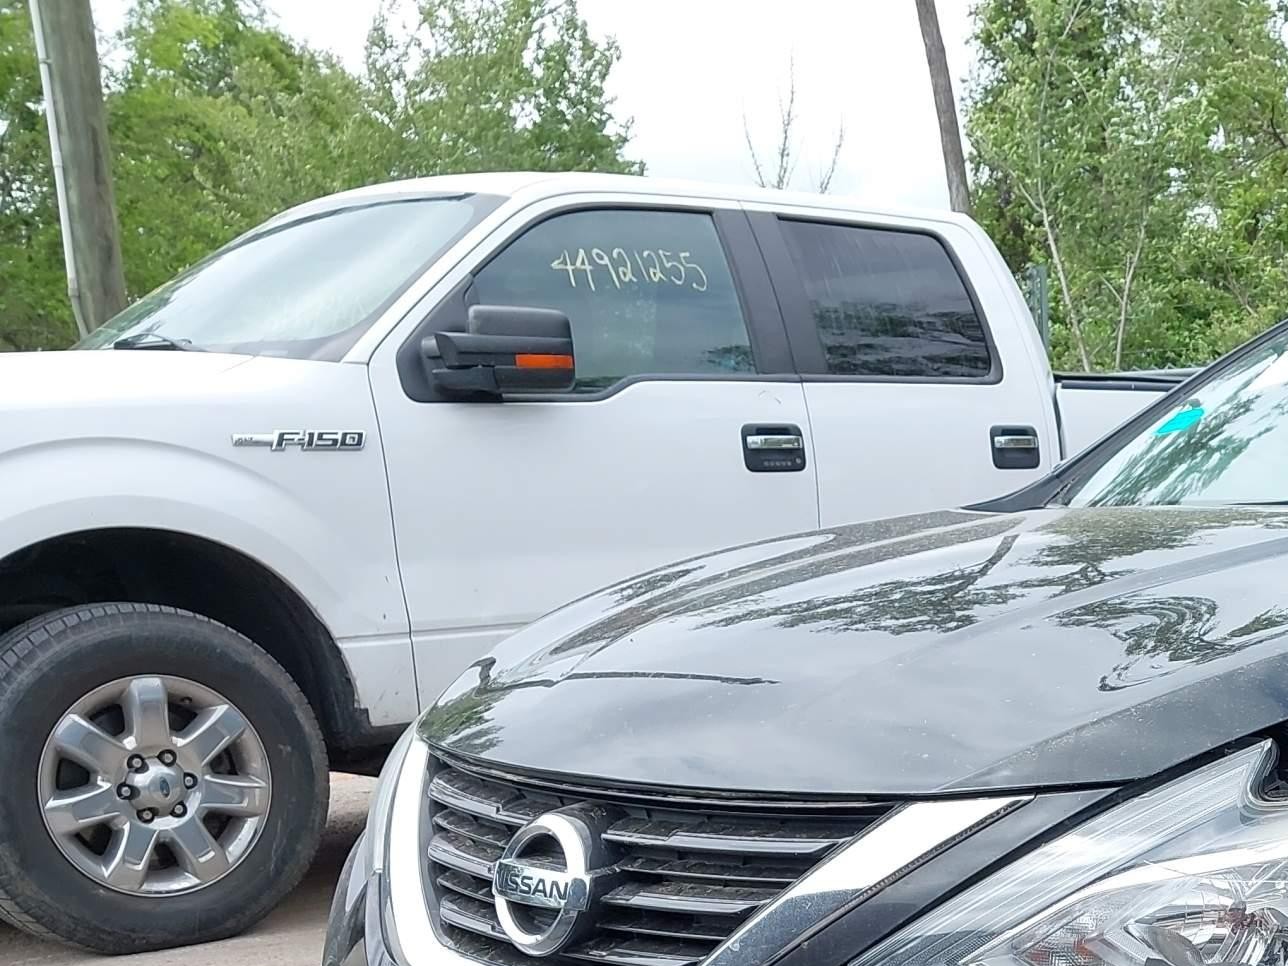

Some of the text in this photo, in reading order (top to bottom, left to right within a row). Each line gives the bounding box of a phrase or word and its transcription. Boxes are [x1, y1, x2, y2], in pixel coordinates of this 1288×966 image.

[550, 247, 708, 292] 44921255
[275, 430, 365, 450] F-150
[496, 866, 569, 901] NISSAN
